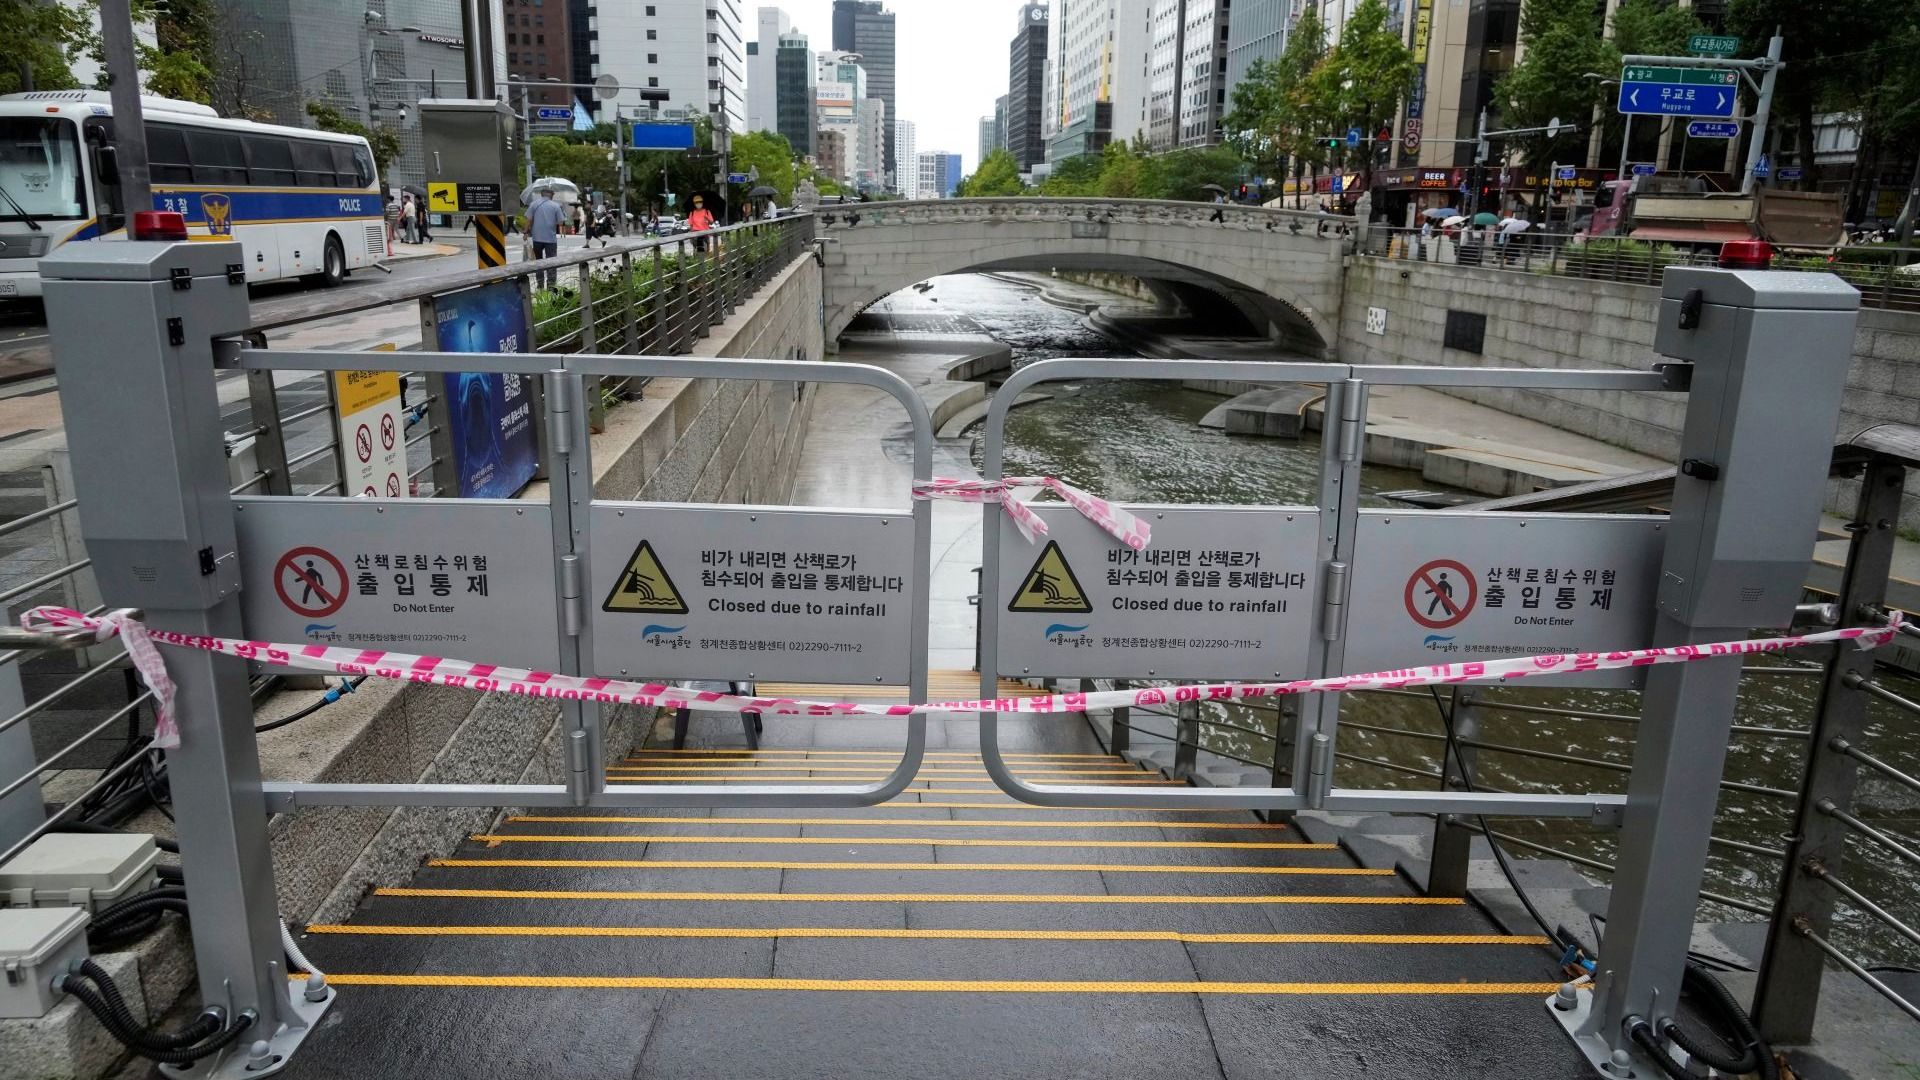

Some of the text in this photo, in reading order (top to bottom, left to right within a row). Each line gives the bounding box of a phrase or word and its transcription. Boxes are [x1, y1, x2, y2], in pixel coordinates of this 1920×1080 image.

[1416, 15, 1428, 50] 고바우
[1637, 70, 1725, 83] 광교 시청
[1660, 88, 1696, 101] 무교로
[1662, 103, 1691, 111] Mugyo-ro
[1424, 172, 1446, 181] BEER
[1578, 178, 1594, 187] Bar
[164, 197, 188, 216] 경찰
[338, 198, 362, 212] POLICE
[700, 550, 856, 571] 비가 내리면 산책로가
[1107, 549, 1260, 568] 비가 내리면 산책로가
[701, 569, 904, 593] 침수되어 출입을 통제합니다
[1106, 569, 1306, 590] 침수되어 출입을 통제합니다
[393, 603, 455, 614] Do Not Enter
[708, 598, 887, 617] Closed due to rainfall
[1112, 596, 1287, 613] Closed due to rainfall
[1514, 615, 1574, 627] Do Not Enter
[646, 634, 691, 649] 서울시설공단
[700, 638, 786, 651] 청계천종합상황센터
[1049, 633, 1093, 648] 서울시설공단
[1102, 637, 1186, 649] 청계천종합상황센터
